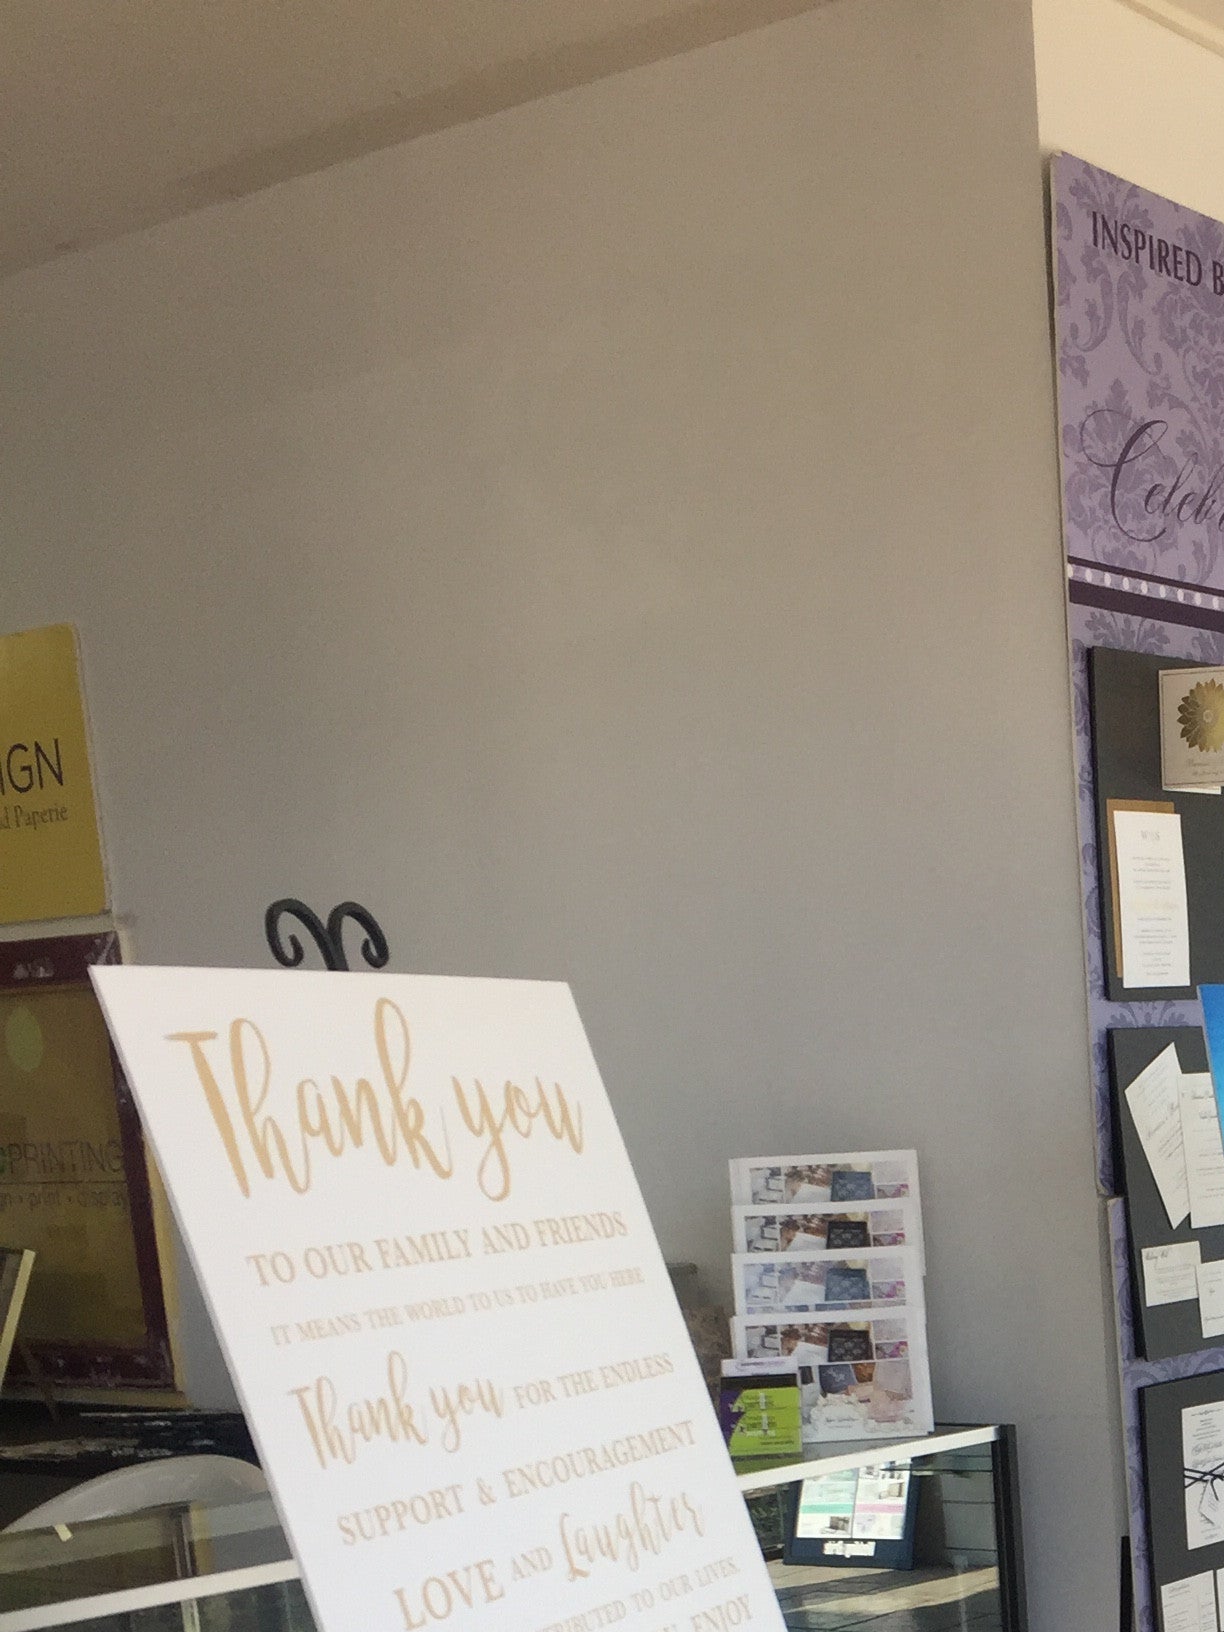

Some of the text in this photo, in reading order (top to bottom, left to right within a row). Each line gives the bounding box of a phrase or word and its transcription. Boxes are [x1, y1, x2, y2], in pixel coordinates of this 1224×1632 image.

[1092, 211, 1202, 288] INSPIRED
[164, 997, 584, 1202] Thank you
[246, 1211, 629, 1287] TO OUR FAMILY AND FRIENDS
[270, 1326, 292, 1347] IT
[295, 1312, 362, 1343] MEANS
[363, 1306, 404, 1331] THE
[404, 1296, 467, 1323] WORLD
[467, 1292, 493, 1312] TO
[515, 1285, 540, 1304] TO
[539, 1277, 579, 1301] HAVE
[579, 1272, 608, 1293] YOU
[609, 1266, 646, 1288] HERE
[287, 1350, 675, 1470] Thank you FOR THE ENDLESS
[336, 1418, 698, 1546] SUPPORT & ENCOURAGEMENT
[394, 1481, 705, 1632] LOVE AND Laughter
[631, 1588, 656, 1613] TO
[658, 1573, 695, 1602] OUR
